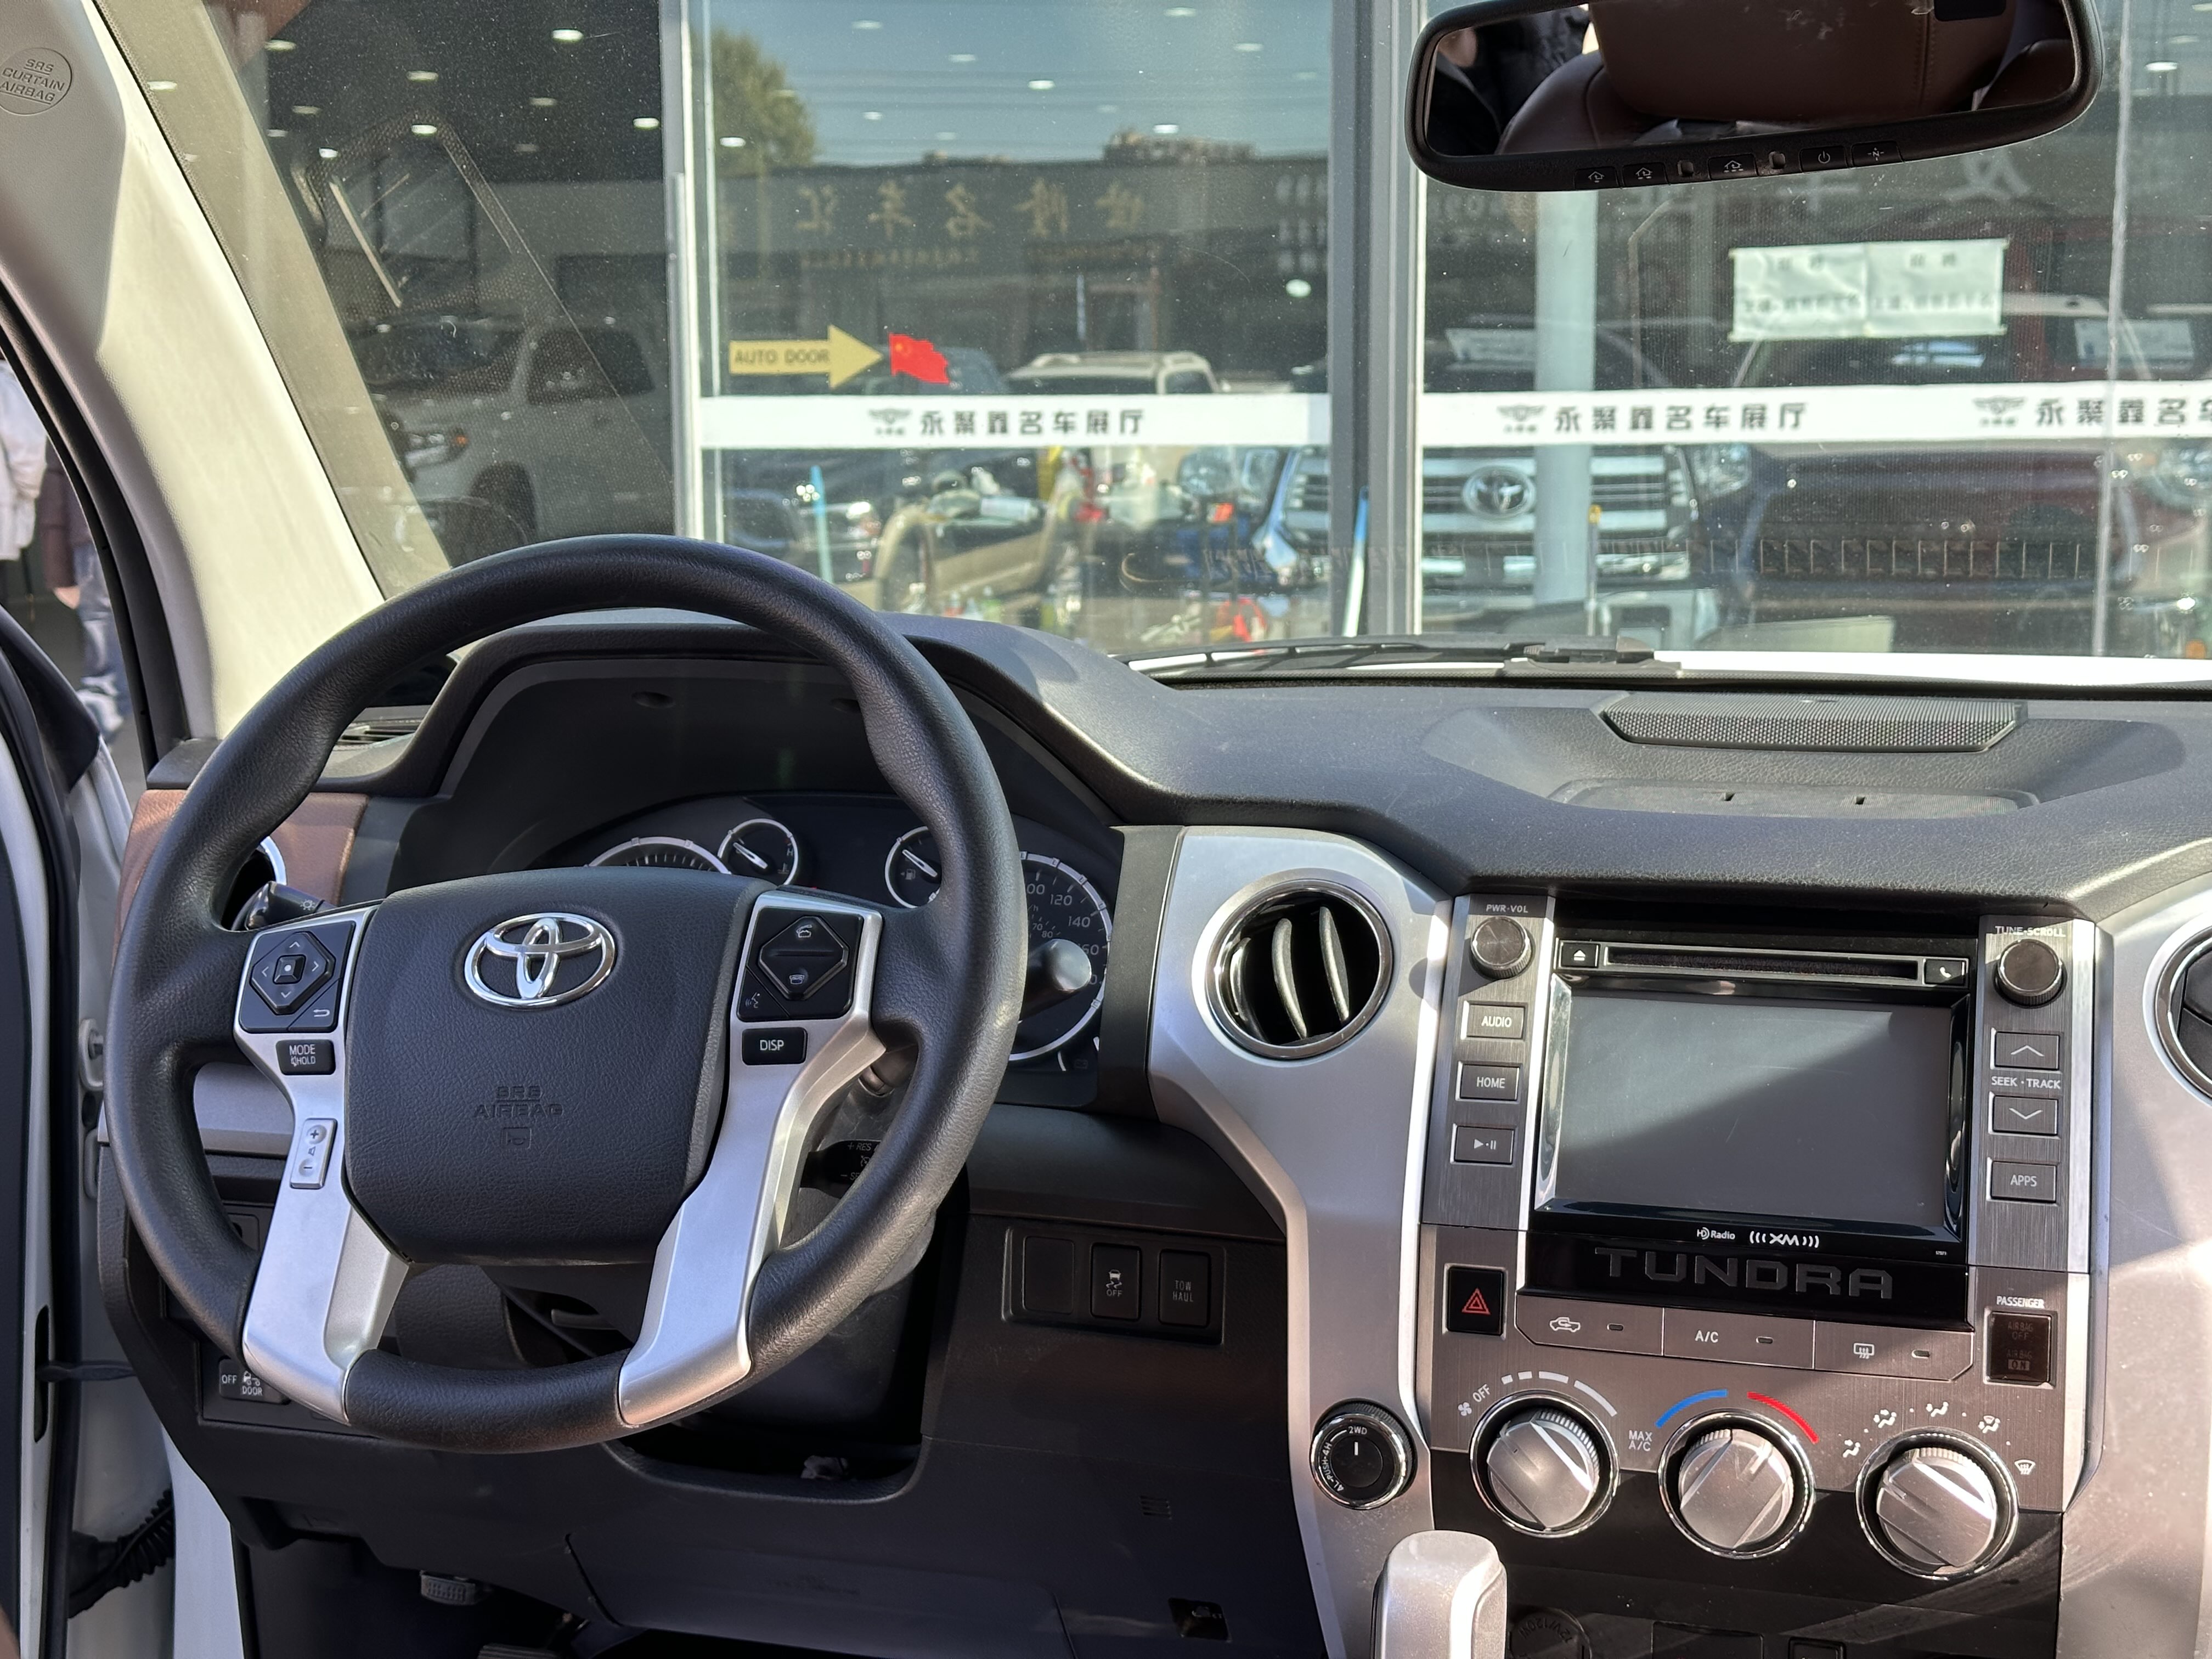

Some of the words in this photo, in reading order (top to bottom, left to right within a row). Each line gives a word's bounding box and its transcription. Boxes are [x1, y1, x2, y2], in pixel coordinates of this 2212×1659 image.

[25, 59, 54, 73] SRS
[2, 67, 65, 91] CURTAIN
[0, 81, 55, 102] AIRBAG
[734, 349, 778, 364] AUTO
[784, 348, 830, 364] DOOR
[1026, 883, 1045, 895] 00
[1050, 894, 1072, 905] 120
[1068, 916, 1091, 928] 140
[1079, 944, 1099, 955] 60
[1481, 1015, 1512, 1028] AUDIO
[289, 1044, 316, 1056] MODE
[759, 1039, 785, 1051] DISP
[297, 1056, 316, 1065] HOLD
[1476, 1076, 1505, 1088] HOME
[474, 1104, 564, 1118] AIRBAG
[850, 1172, 861, 1181] SE
[2010, 1175, 2037, 1187] APPS
[1711, 1230, 1736, 1240] Radio
[1595, 1247, 1892, 1299] TUNDRA
[1175, 1280, 1192, 1291] TOW
[1172, 1291, 1194, 1302] HAUL
[1996, 1295, 2045, 1309] PASSENGER
[1695, 1329, 1719, 1343] A/C
[2011, 1331, 2029, 1340] OFF
[222, 1374, 237, 1384] OFF
[242, 1386, 263, 1396] DOOR
[1472, 1384, 1490, 1402] OFF
[1348, 1426, 1368, 1435] 2WD
[1629, 1430, 1652, 1442] MAX
[1628, 1440, 1651, 1452] A/C
